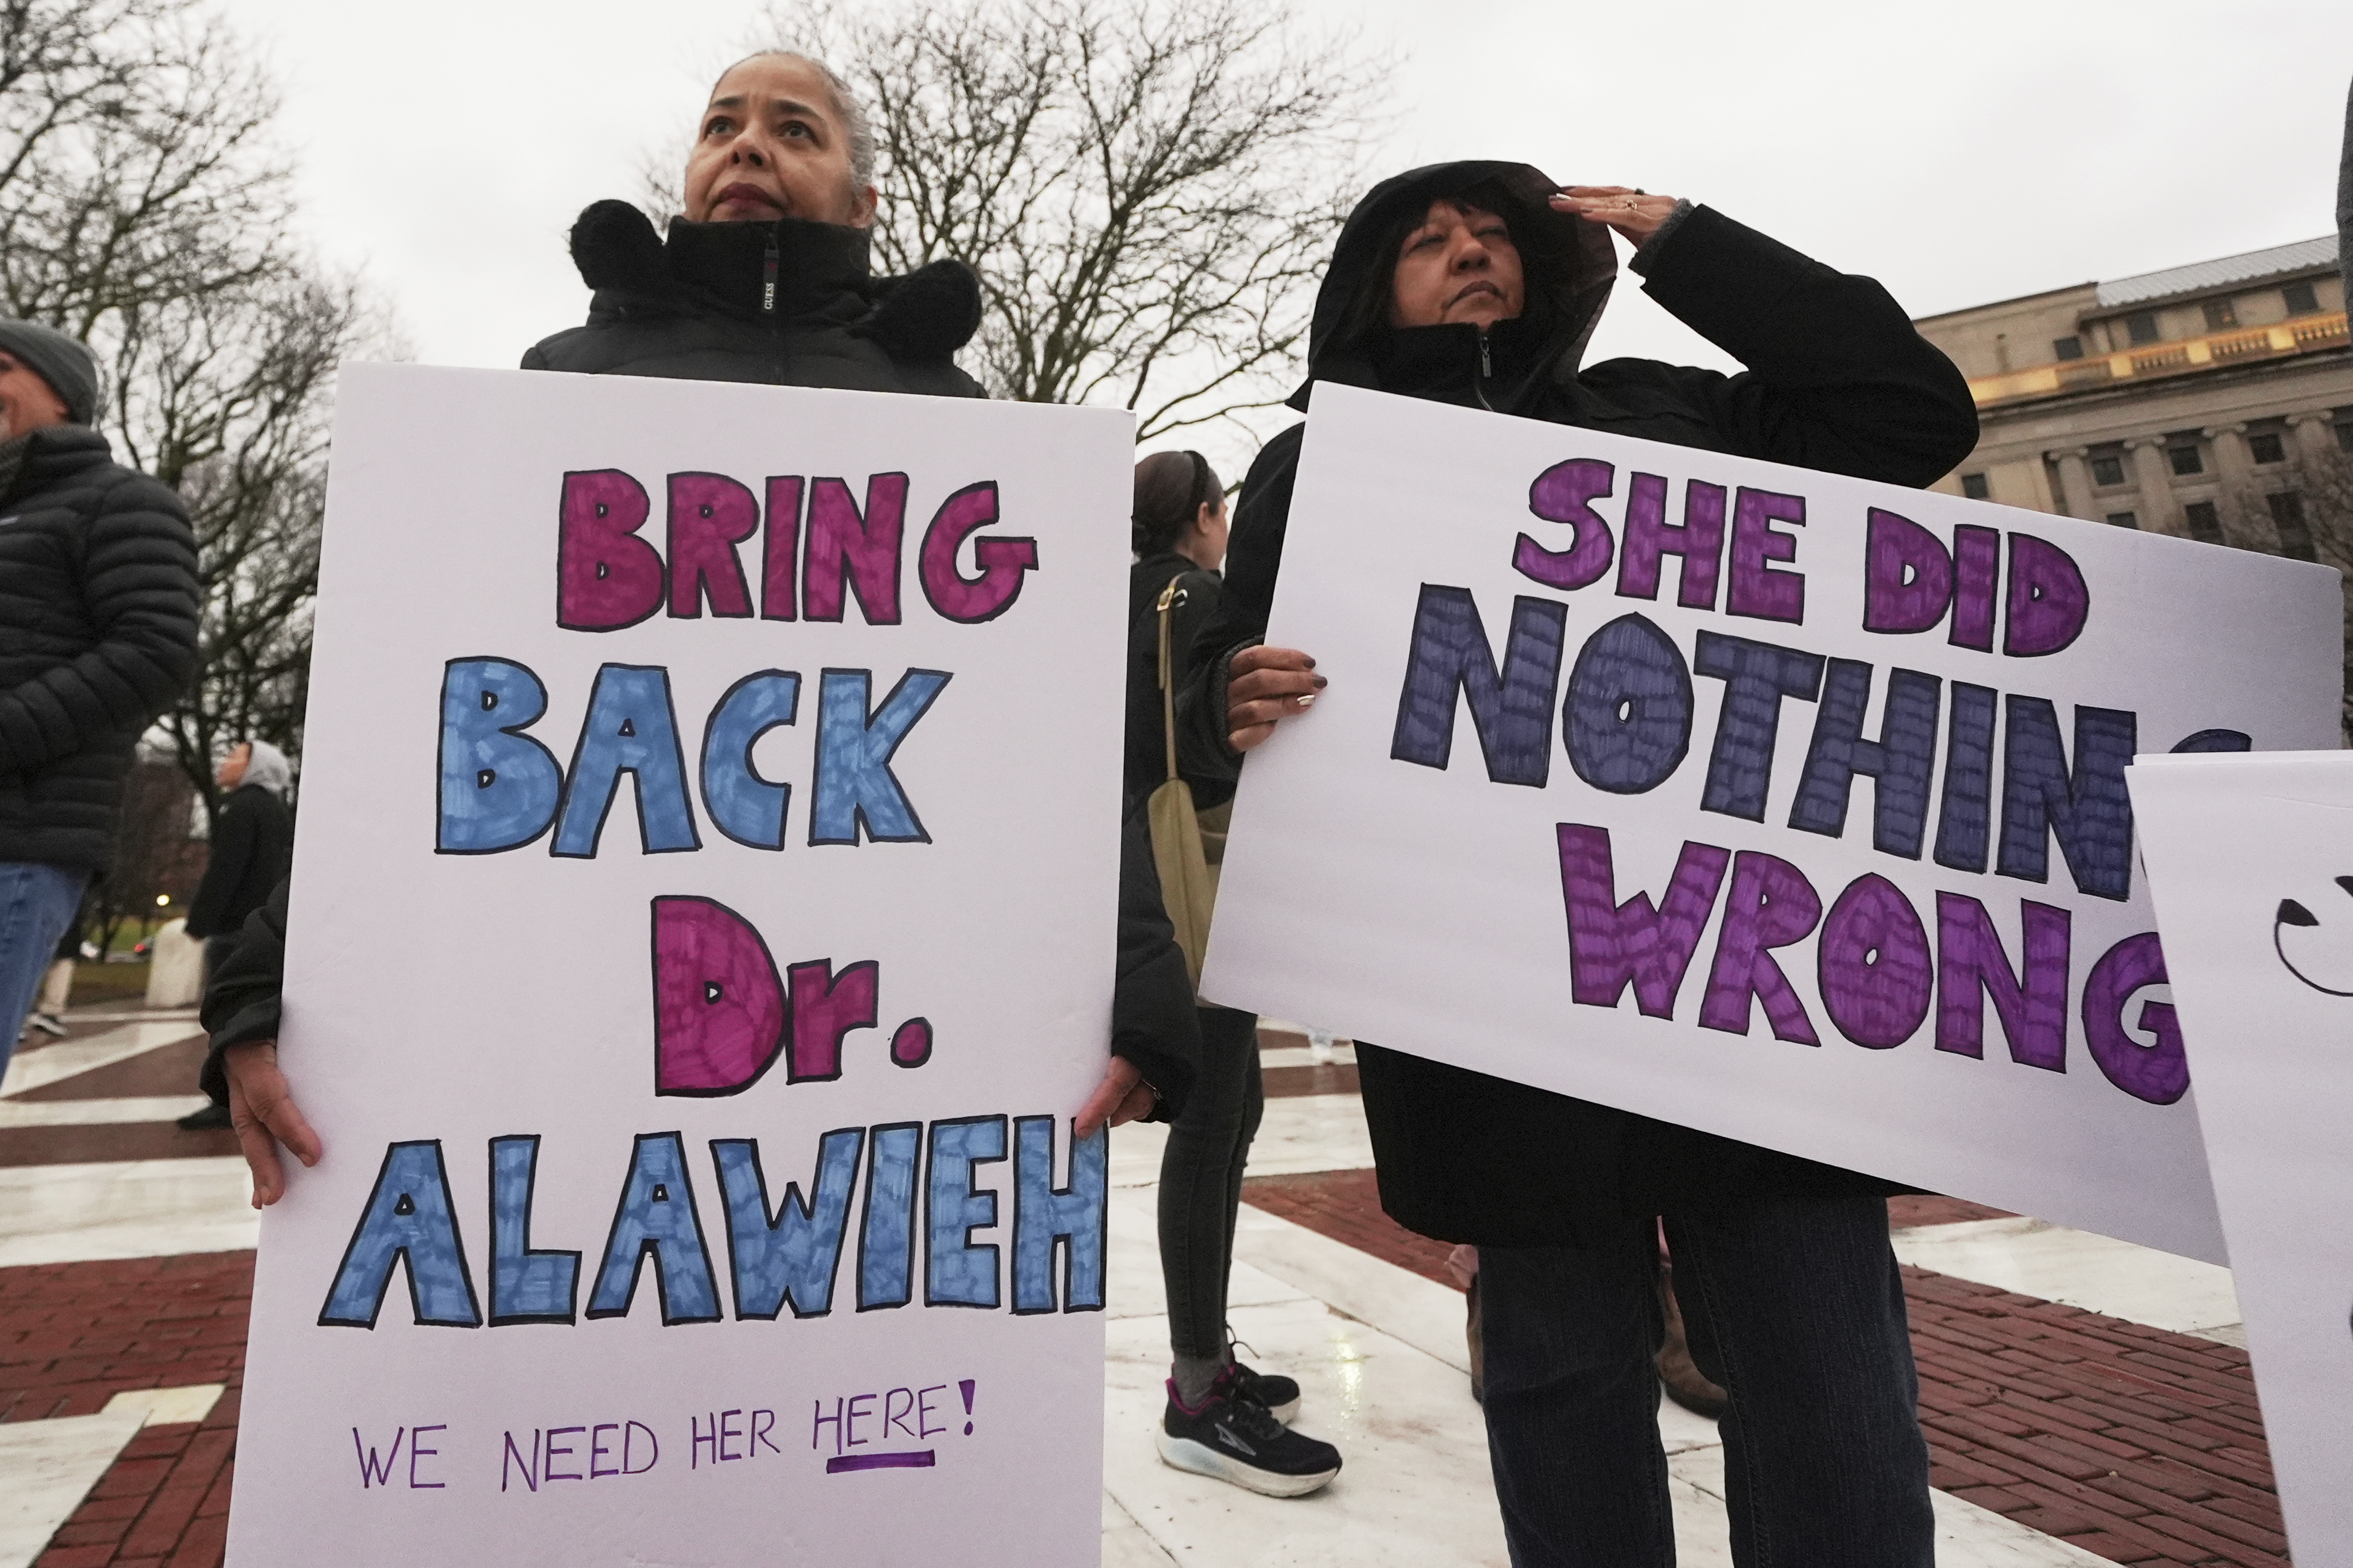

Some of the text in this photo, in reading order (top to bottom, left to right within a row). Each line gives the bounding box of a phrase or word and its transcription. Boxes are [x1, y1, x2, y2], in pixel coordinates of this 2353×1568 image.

[764, 282, 775, 310] GUESS
[556, 468, 1039, 633] BRING
[1512, 458, 2091, 658] SHE DID
[434, 656, 954, 859] BACK
[1390, 581, 2252, 902] NOTHIN
[651, 895, 933, 1098] Dr.
[1556, 822, 2191, 1106] WRONG
[317, 1113, 1108, 1331] ALAWIEH
[353, 1379, 975, 1493] WE NEED HER HERE!
